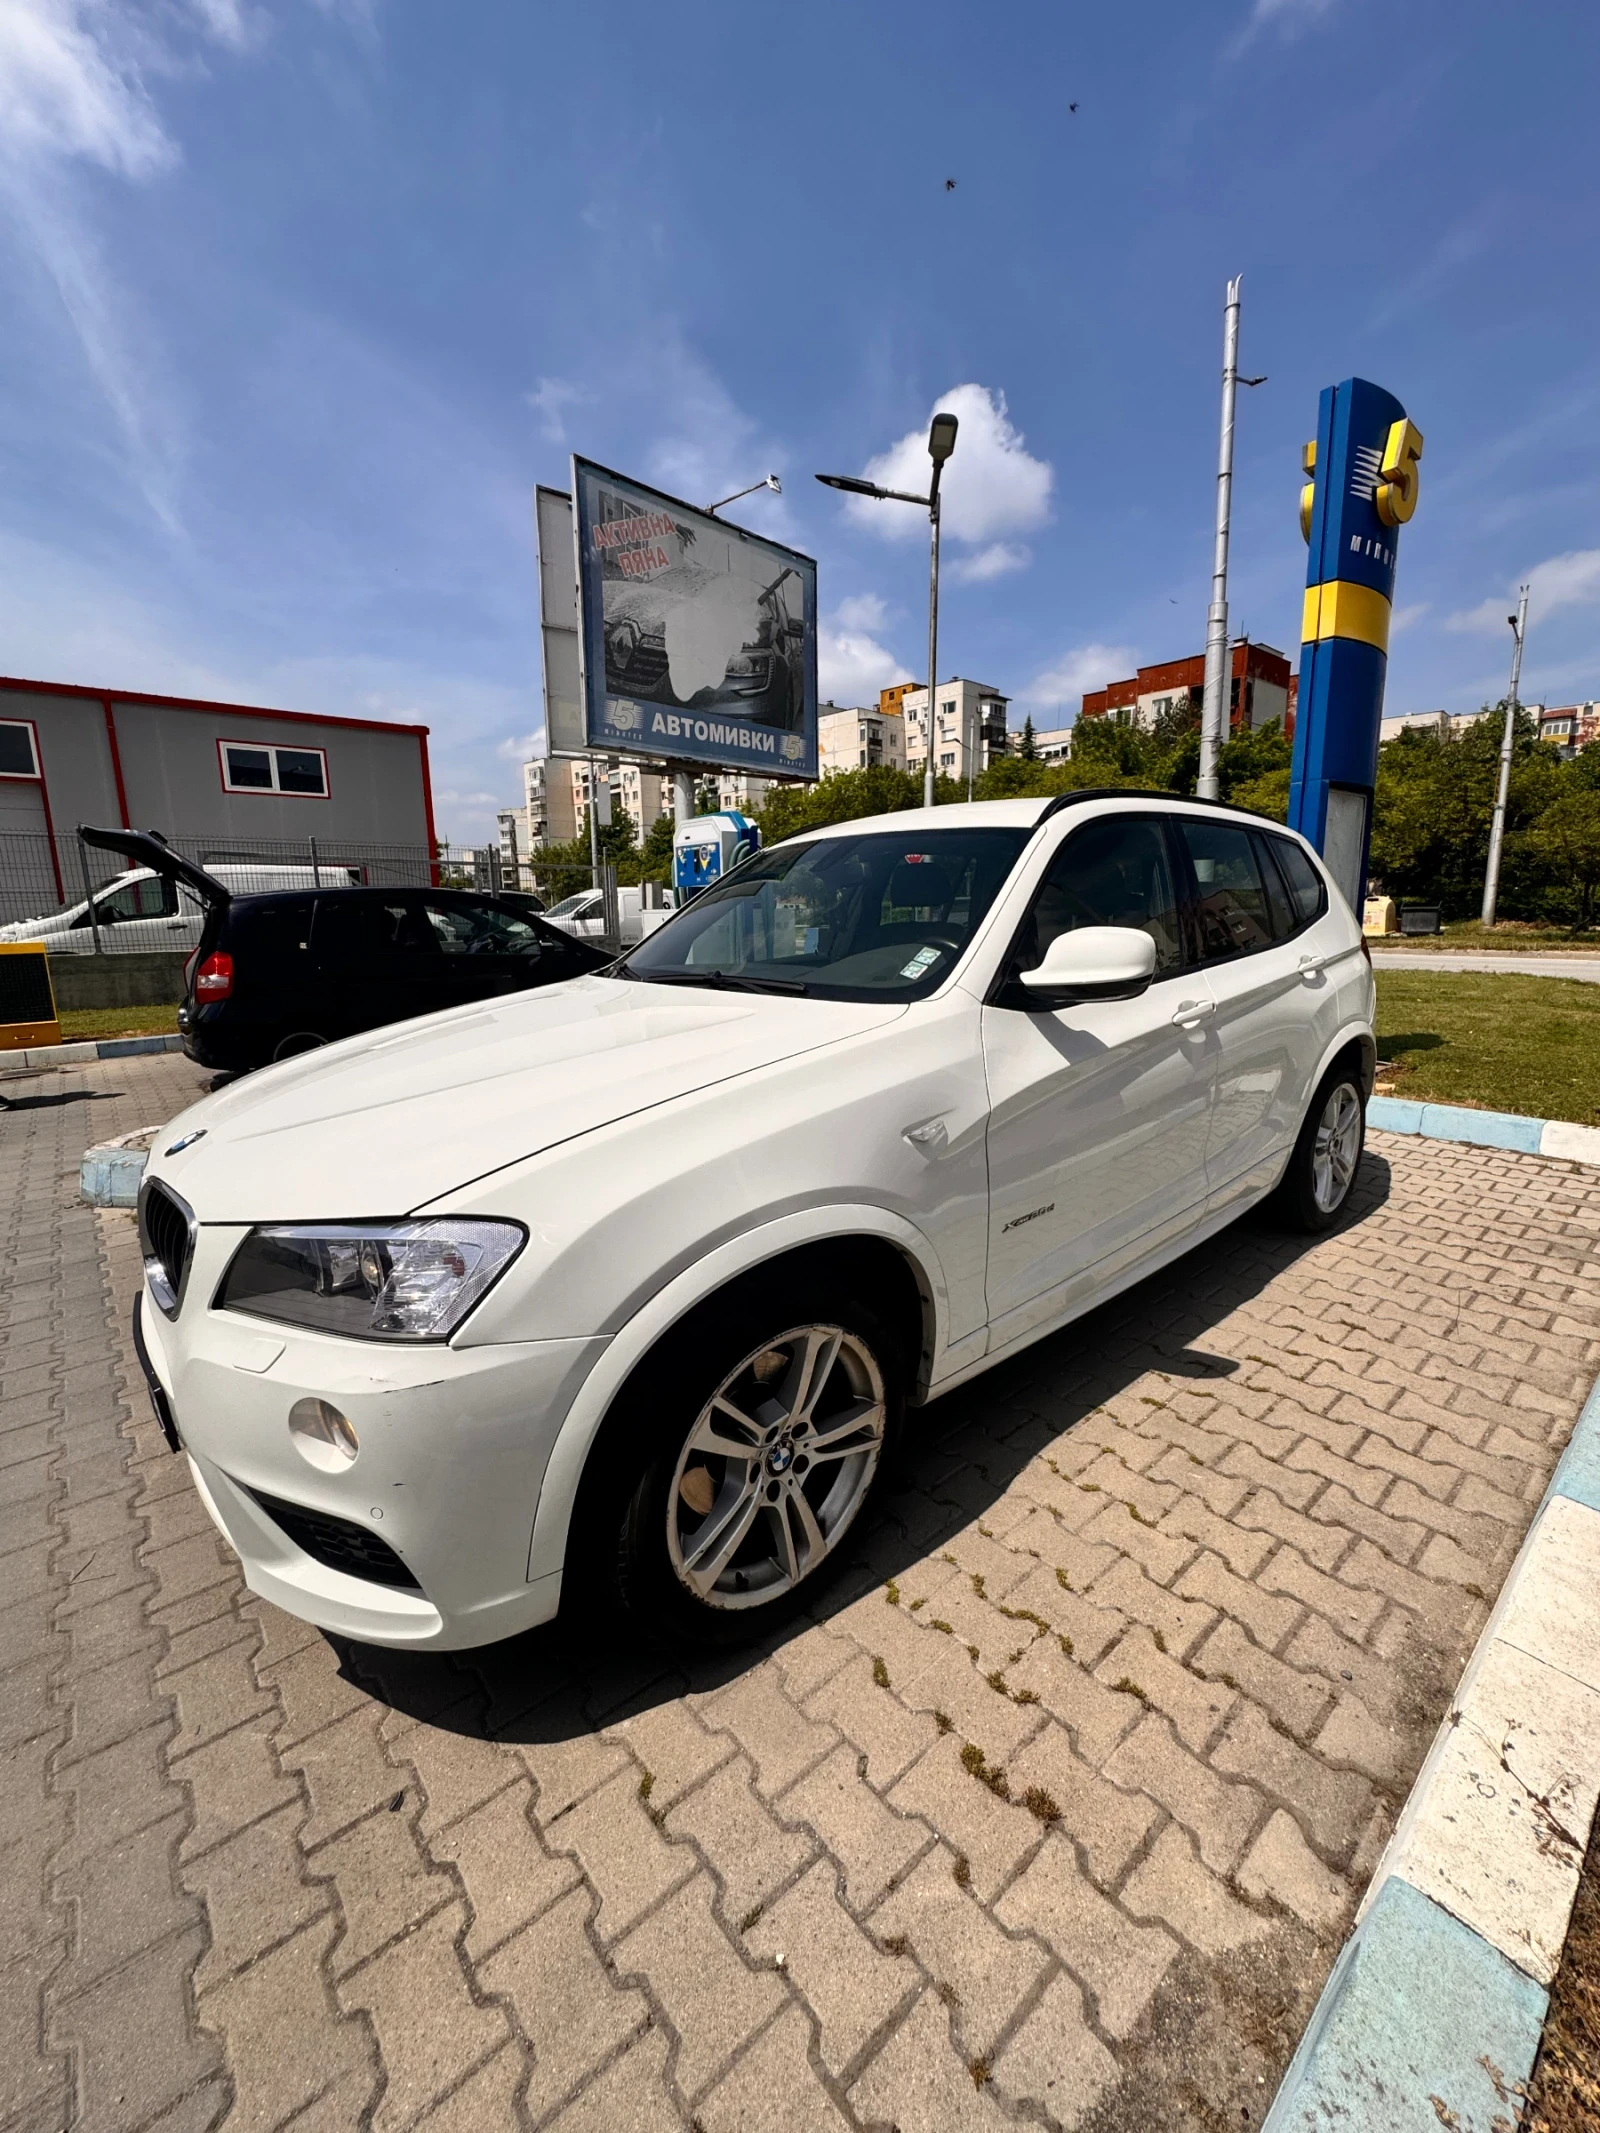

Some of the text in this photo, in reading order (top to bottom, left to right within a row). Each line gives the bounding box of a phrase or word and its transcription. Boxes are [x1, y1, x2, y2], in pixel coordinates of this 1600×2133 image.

[1376, 417, 1424, 527] 5
[593, 513, 677, 550] АКТИВНА
[618, 545, 671, 577] ПЯНА
[612, 699, 635, 730] 5
[651, 712, 775, 753] АВТОМИВКИ
[785, 735, 800, 760] 5
